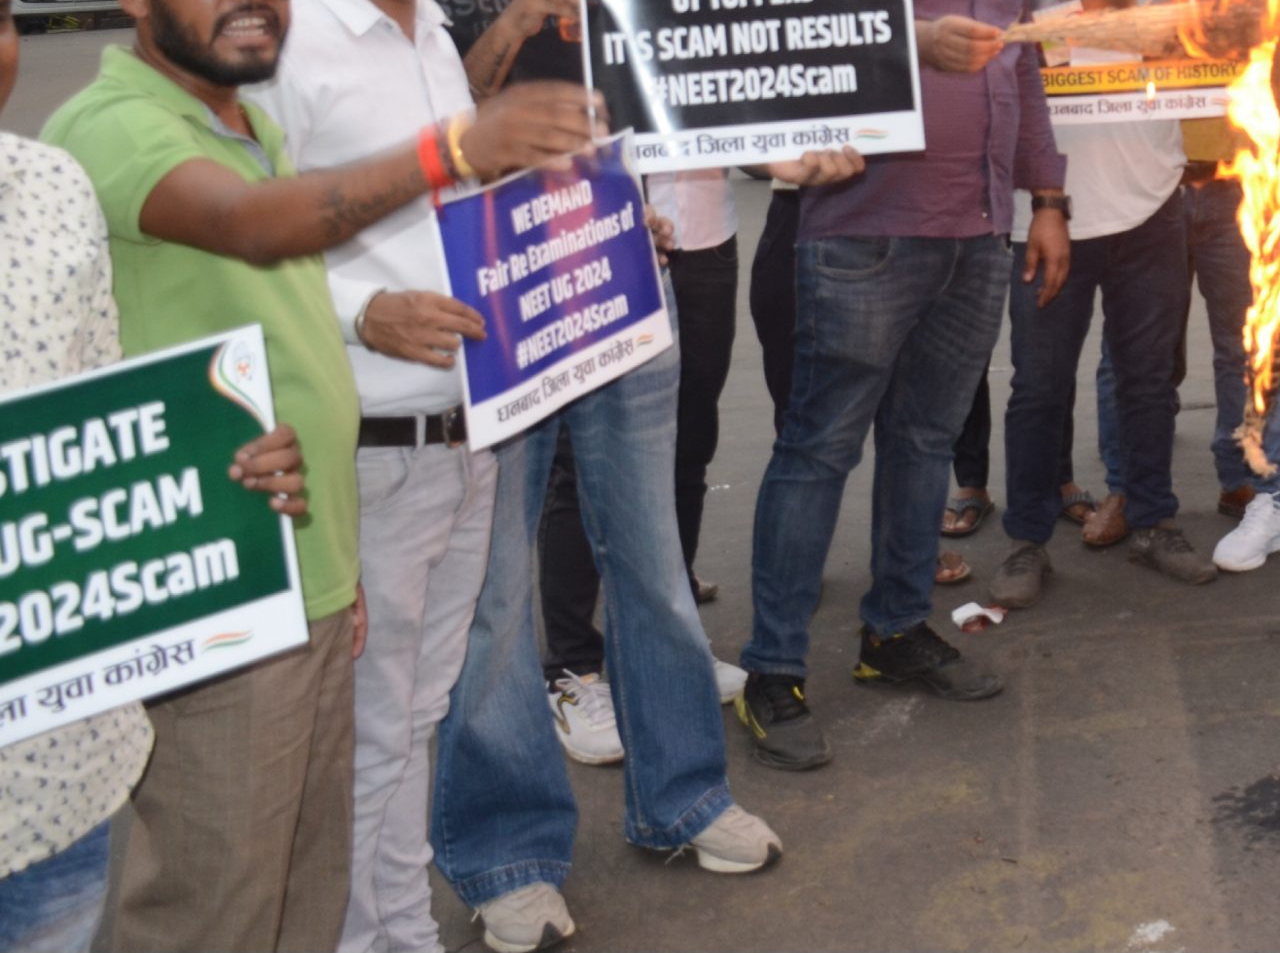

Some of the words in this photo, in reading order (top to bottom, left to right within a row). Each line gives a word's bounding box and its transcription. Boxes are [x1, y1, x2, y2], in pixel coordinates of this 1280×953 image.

[657, 23, 728, 62] SCAM
[731, 20, 781, 56] NOT
[785, 11, 892, 51] RESULTS
[652, 64, 858, 106] #NEET2024Scam
[1042, 70, 1105, 88] BIGGEST
[1107, 67, 1150, 84] SCAM
[1154, 65, 1174, 81] OF
[1177, 62, 1238, 79] HISTORY
[1097, 99, 1133, 115] जिला
[1136, 98, 1161, 114] युवा
[1164, 96, 1207, 111] कांग्रेस
[696, 133, 746, 156] जिला
[752, 131, 787, 154] युवा
[792, 126, 850, 146] कांग्रेस
[511, 202, 534, 235] WE
[533, 179, 593, 224] DEMAND
[476, 255, 508, 297] Fair
[508, 252, 530, 283] Re
[527, 212, 620, 275] Examinations
[620, 201, 635, 236] of
[518, 282, 552, 323] NEET
[551, 273, 574, 306] UG
[574, 256, 613, 294] 2024
[515, 293, 630, 371] #NEET2024Scam
[495, 389, 543, 424] धनबाद
[541, 371, 571, 402] जिला
[572, 360, 597, 386] युवा
[598, 338, 635, 370] कांग्रेस
[0, 400, 170, 496] TIGATE
[36, 672, 95, 714] युवा
[103, 637, 197, 687] कांग्रेस
